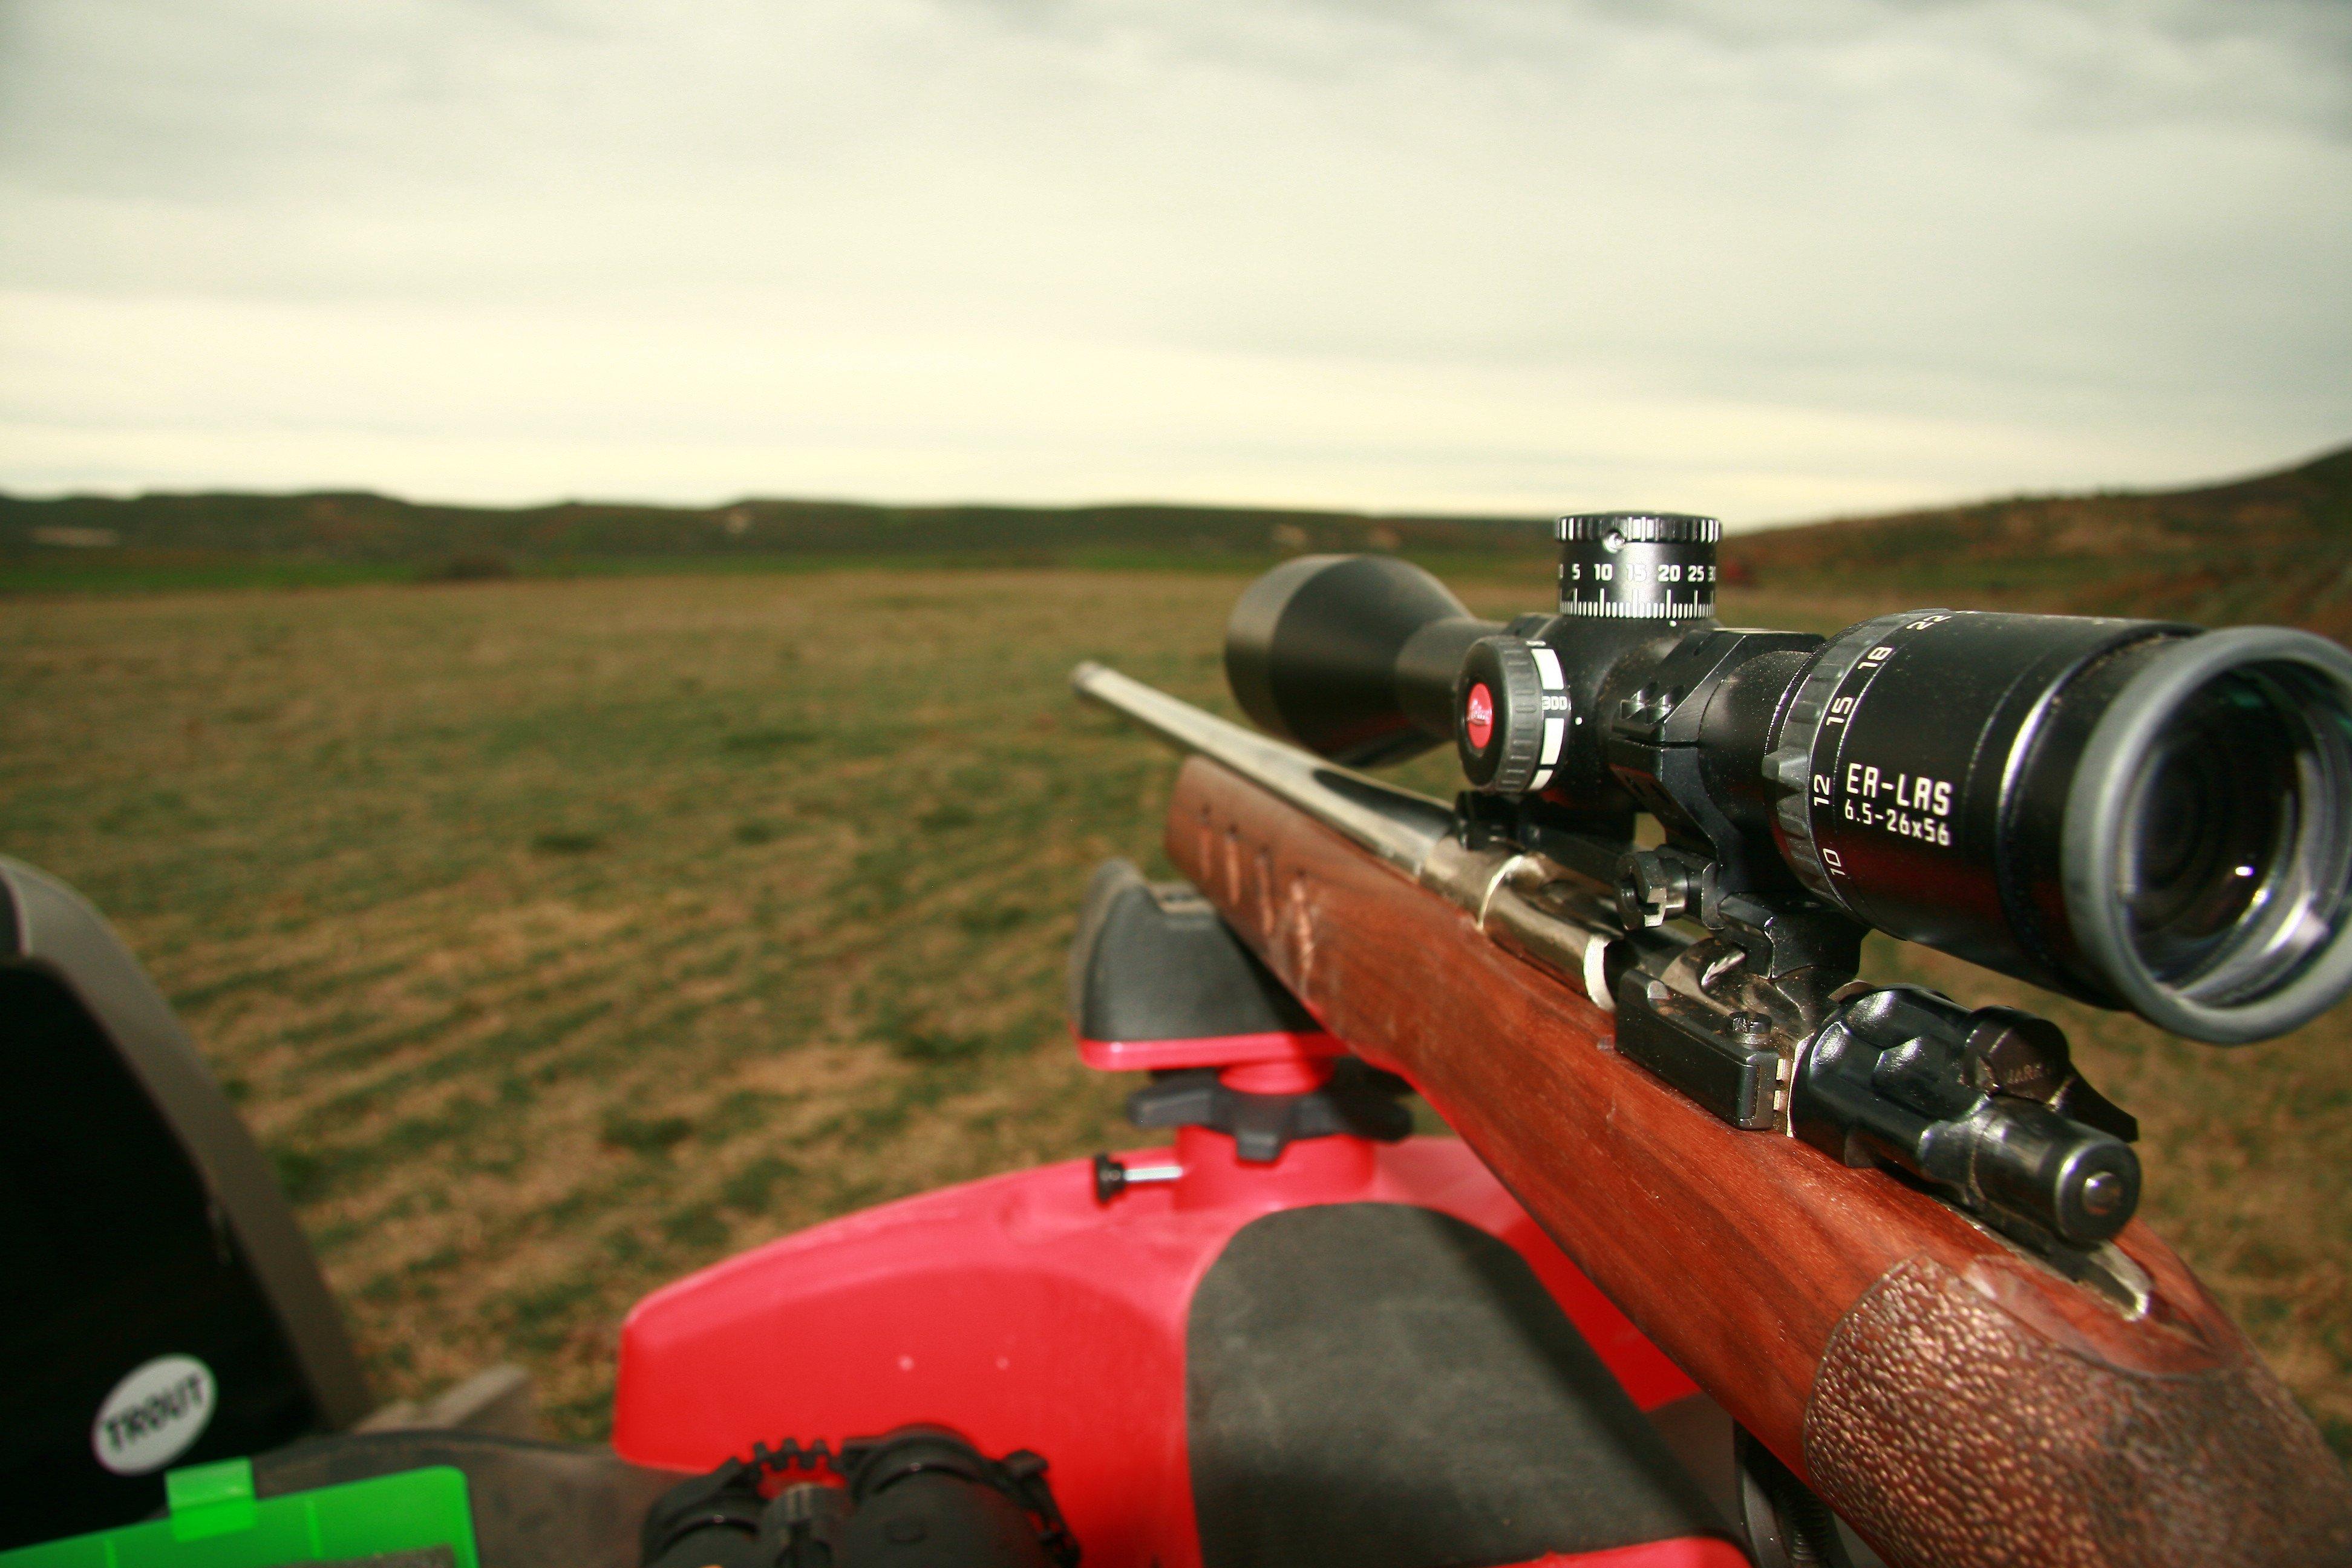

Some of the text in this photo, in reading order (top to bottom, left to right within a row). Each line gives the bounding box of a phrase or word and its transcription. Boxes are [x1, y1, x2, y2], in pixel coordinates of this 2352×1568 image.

[1572, 564, 1581, 581] 5
[1593, 563, 1613, 581] 10
[1627, 563, 1647, 581] 15
[1658, 564, 1681, 582] 20
[1687, 565, 1705, 582] 25
[1541, 695, 1568, 711] 300
[1814, 615, 1952, 876] 10 12 15 18 22
[1844, 799, 1951, 846] 6.5-26x56
[104, 1371, 204, 1452] TROUT
